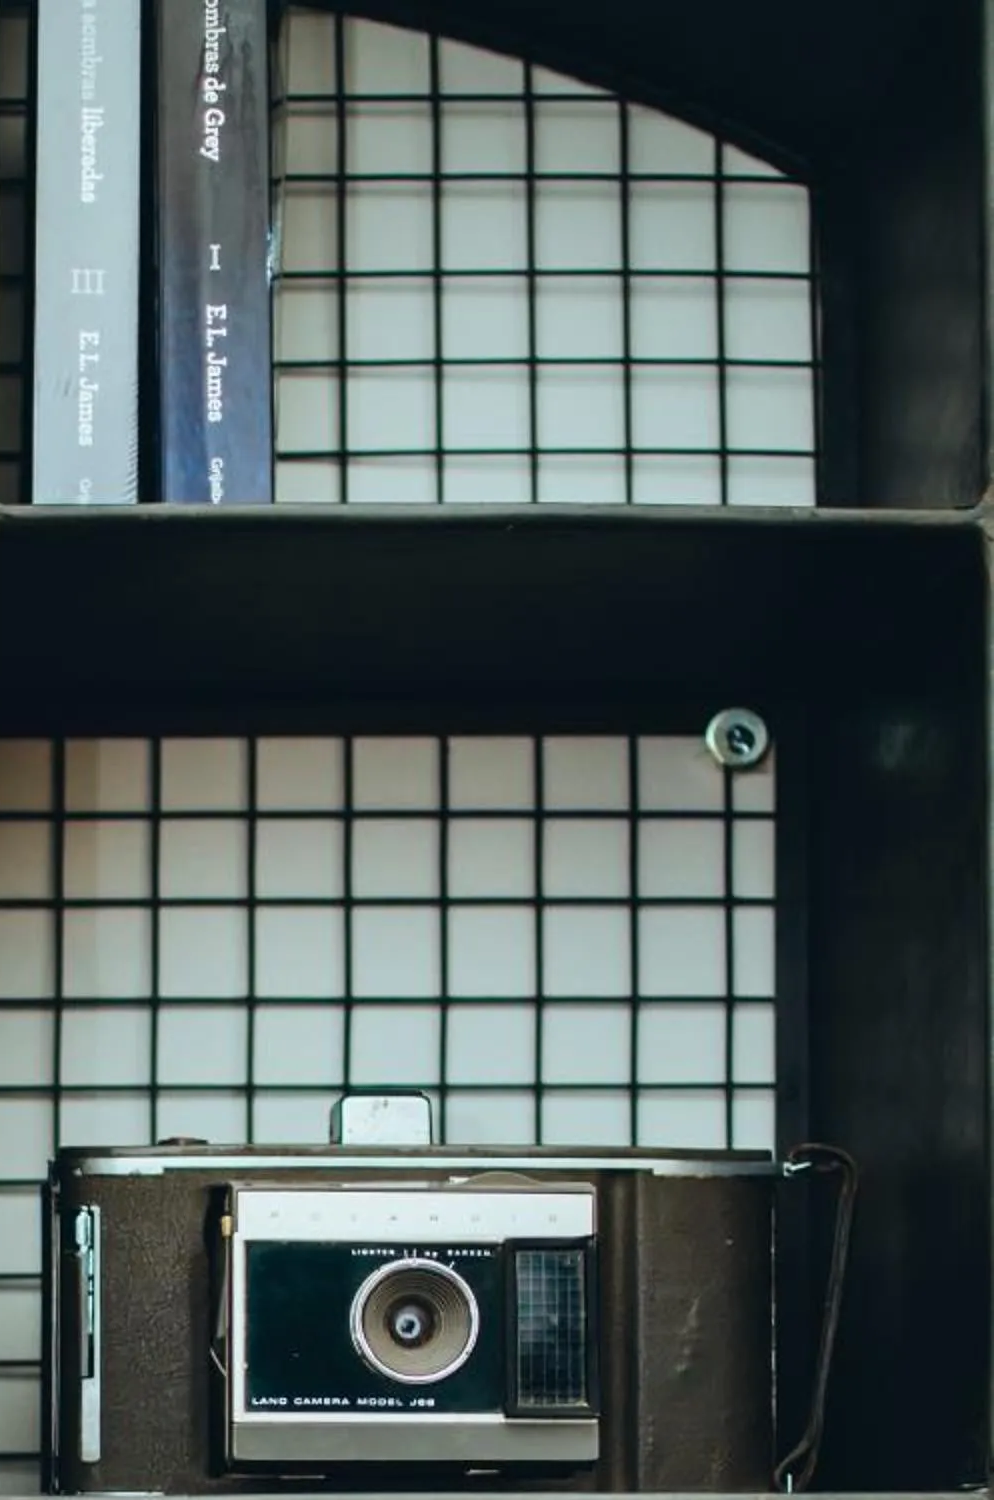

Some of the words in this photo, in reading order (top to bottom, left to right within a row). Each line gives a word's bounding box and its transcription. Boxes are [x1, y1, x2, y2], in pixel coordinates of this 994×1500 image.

[205, 0, 226, 73] ombras
[204, 77, 226, 103] de
[81, 107, 104, 203] liberadas
[200, 108, 225, 162] Grey
[78, 378, 99, 446] James
[207, 354, 227, 422] James
[252, 1397, 288, 1406] LAND
[293, 1397, 350, 1407] CAMERA
[357, 1397, 404, 1407] MODEL
